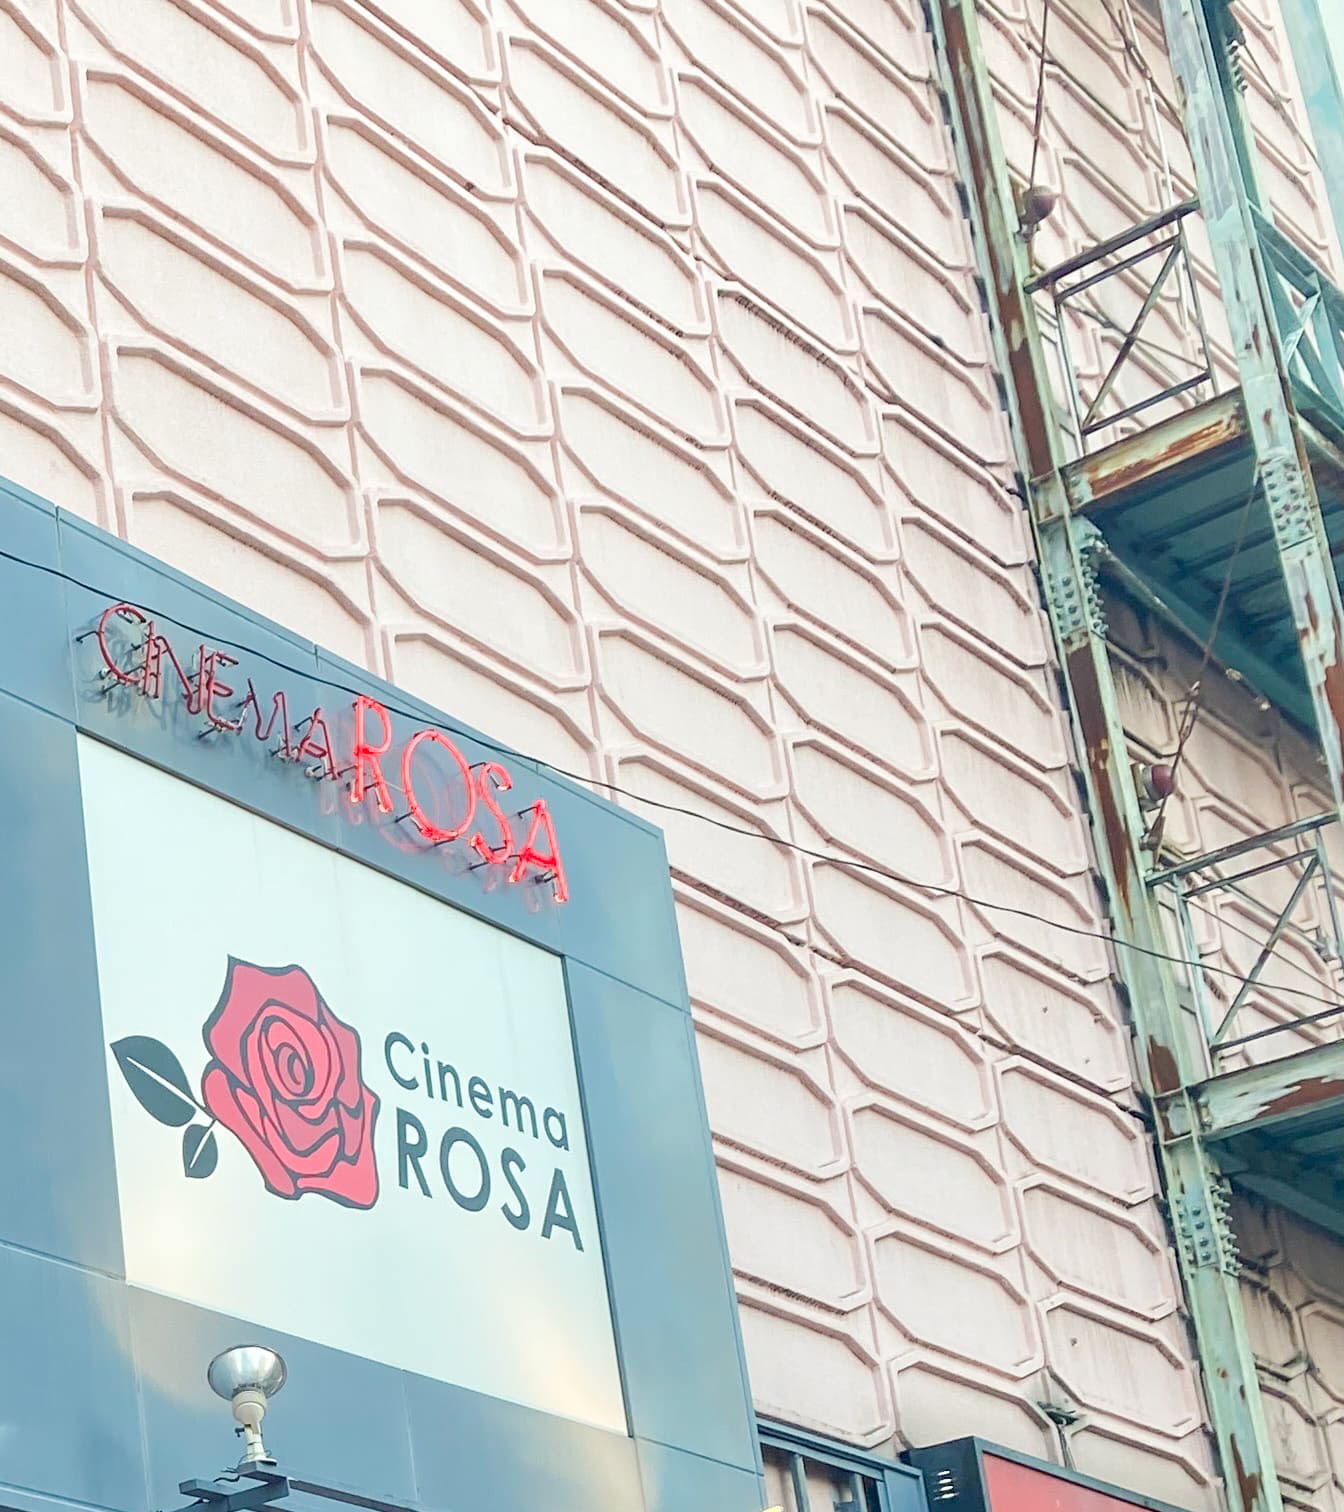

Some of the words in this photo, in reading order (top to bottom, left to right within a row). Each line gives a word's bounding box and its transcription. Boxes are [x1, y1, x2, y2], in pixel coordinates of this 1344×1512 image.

[97, 602, 339, 781] CINEMA
[350, 694, 569, 904] ROSA
[384, 1031, 570, 1152] Cinema
[396, 1107, 585, 1253] ROSA
